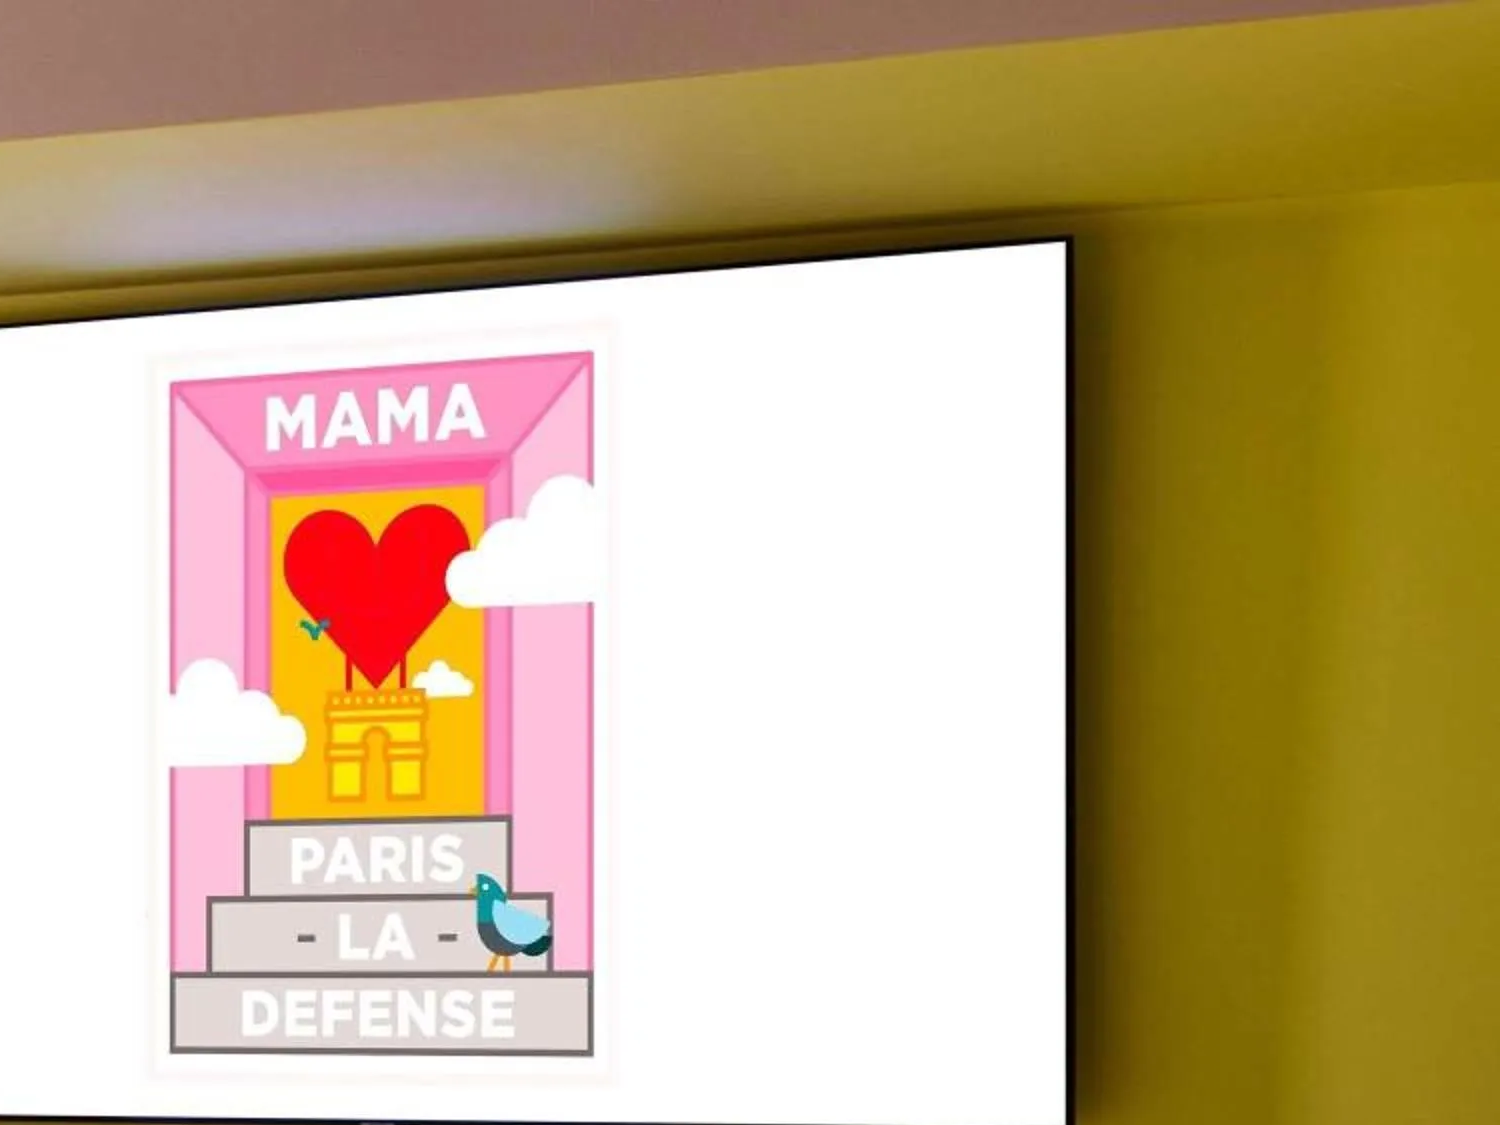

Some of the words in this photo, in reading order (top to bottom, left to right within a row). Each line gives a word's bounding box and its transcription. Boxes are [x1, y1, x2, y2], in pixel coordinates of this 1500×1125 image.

[265, 382, 487, 452] MAMA
[290, 833, 465, 885] PARIS
[338, 912, 416, 961] LA
[241, 989, 516, 1039] DEFENSE
